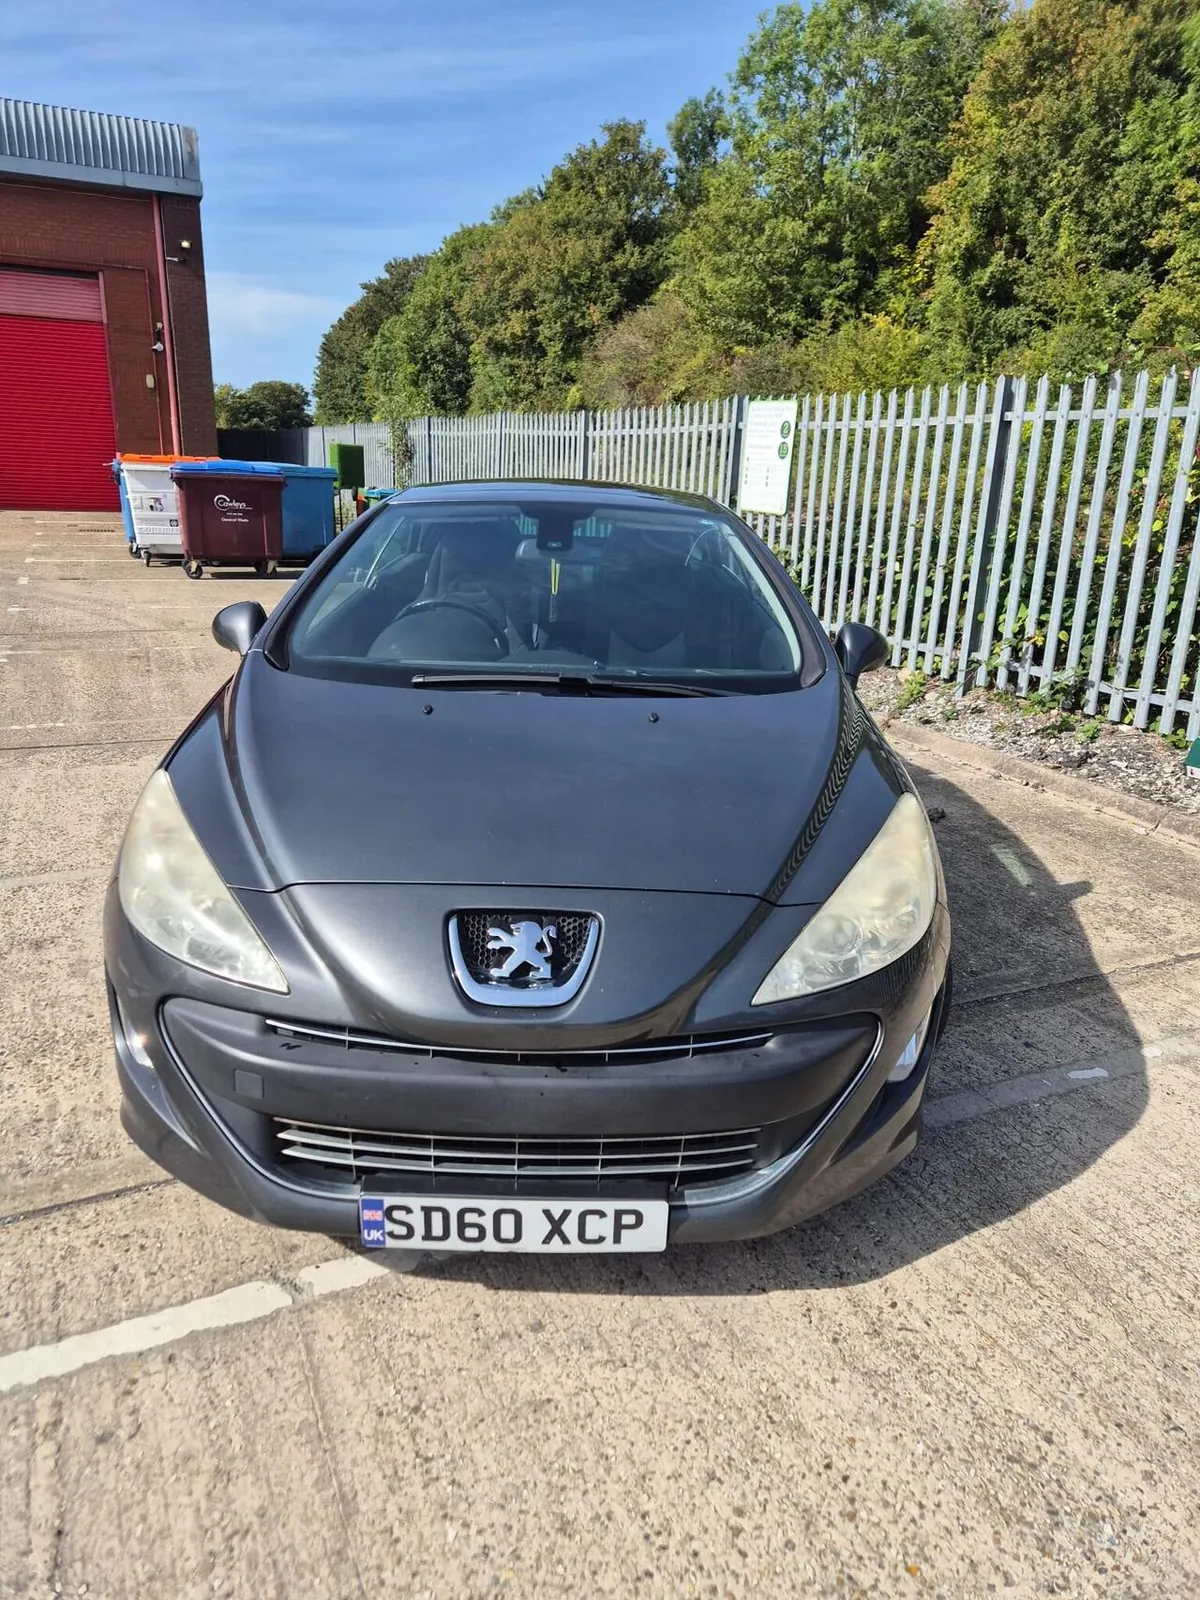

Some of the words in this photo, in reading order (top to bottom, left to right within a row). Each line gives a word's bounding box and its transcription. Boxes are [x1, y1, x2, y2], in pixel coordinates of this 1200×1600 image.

[364, 1229, 385, 1241] UK
[385, 1205, 523, 1244] SD60
[541, 1209, 644, 1245] XCP
